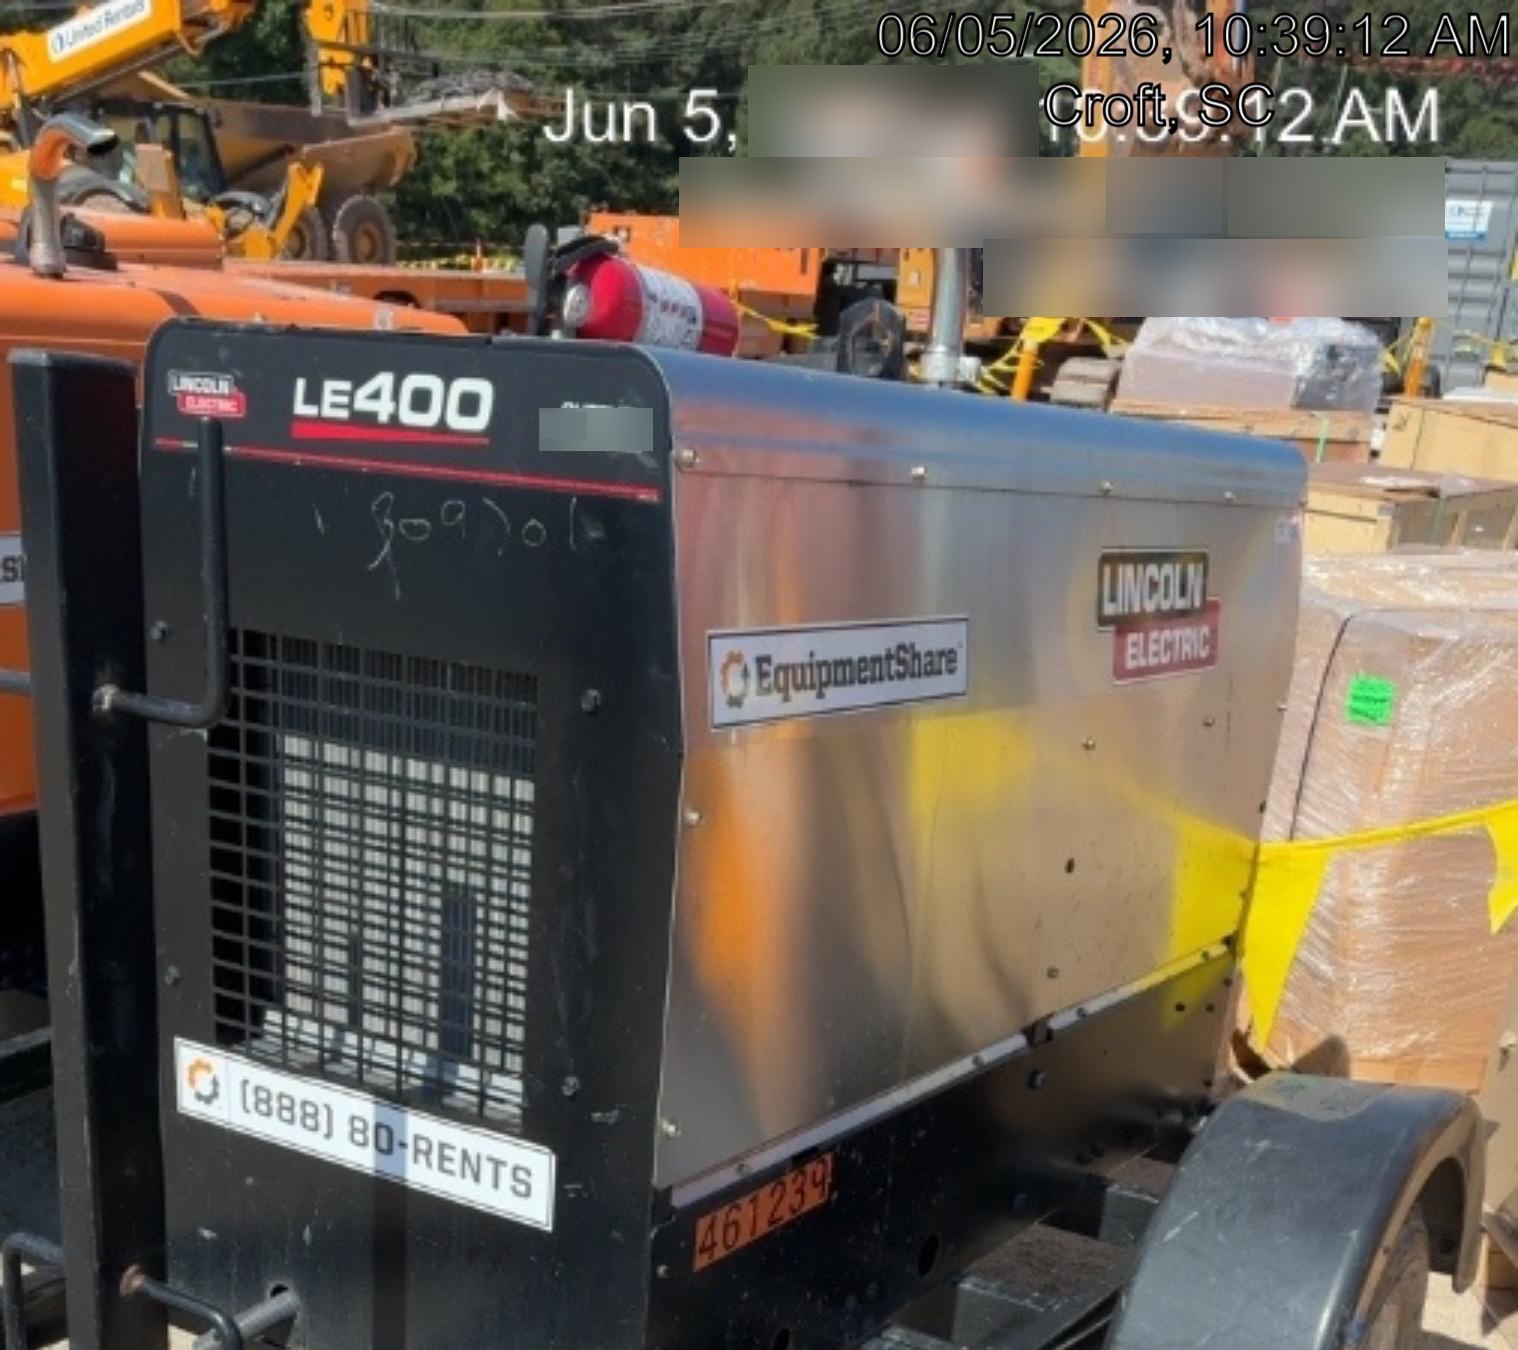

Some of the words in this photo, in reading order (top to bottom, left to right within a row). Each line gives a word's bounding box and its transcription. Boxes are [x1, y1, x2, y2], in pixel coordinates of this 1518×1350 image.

[173, 376, 230, 394] LINCOLN
[293, 371, 494, 432] LE400
[1102, 562, 1204, 617] LINCOLN
[755, 642, 958, 702] EquipmentShare
[1124, 626, 1210, 670] ELECTRIC
[240, 1078, 334, 1140] (888)
[348, 1114, 533, 1199] 80-RENTS
[698, 1157, 828, 1261] 461239
